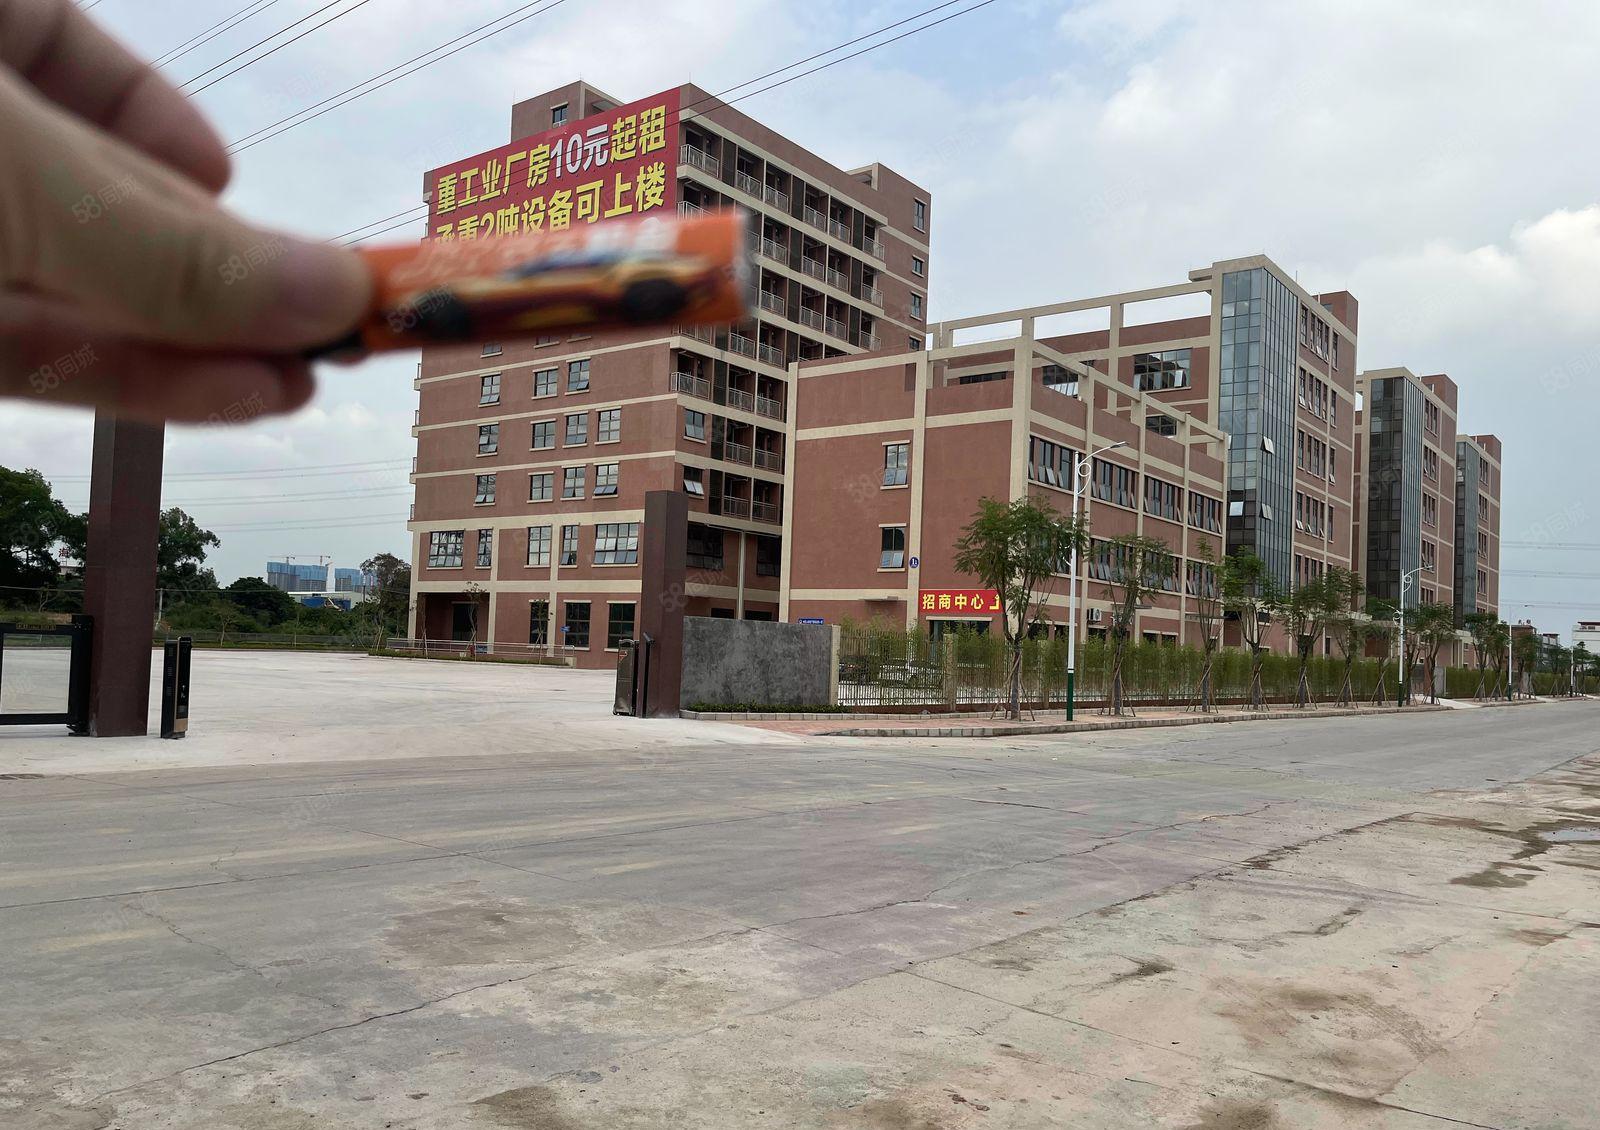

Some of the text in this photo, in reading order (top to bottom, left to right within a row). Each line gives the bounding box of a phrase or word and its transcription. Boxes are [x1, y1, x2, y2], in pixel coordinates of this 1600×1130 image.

[436, 105, 666, 215] 重工业厂房10元起租
[922, 593, 984, 610] 招商中心
